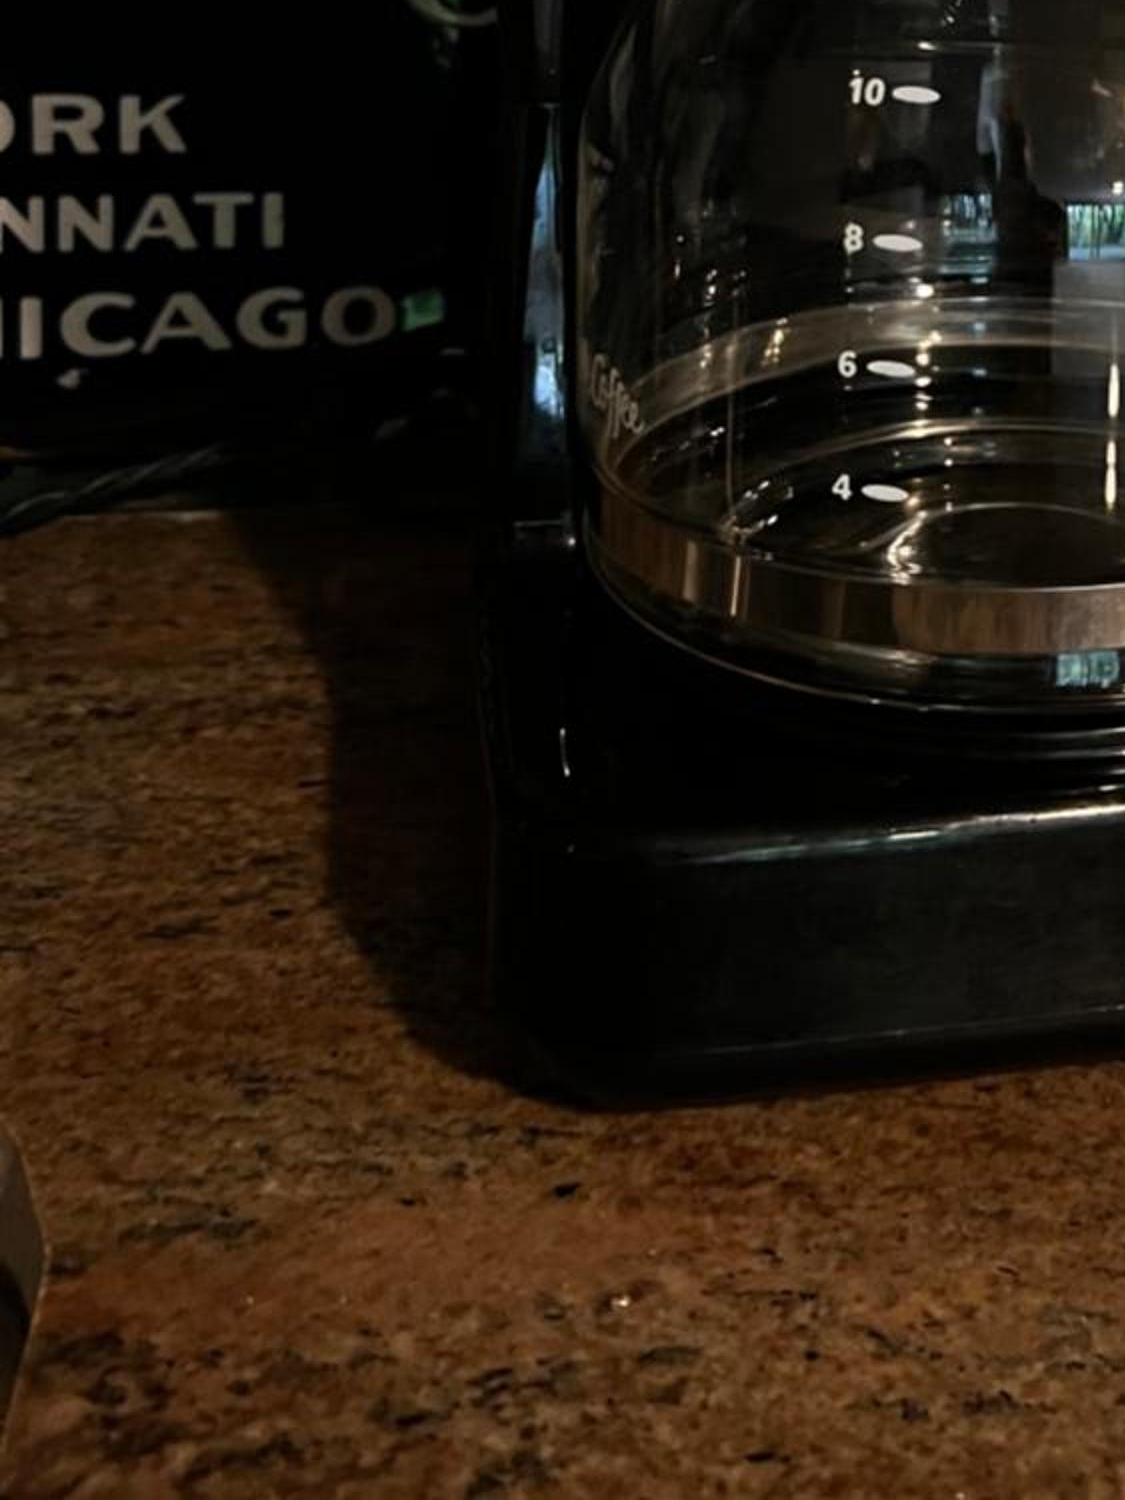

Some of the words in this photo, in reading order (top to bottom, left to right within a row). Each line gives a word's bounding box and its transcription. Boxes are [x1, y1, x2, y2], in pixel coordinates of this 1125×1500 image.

[849, 77, 886, 106] 10
[843, 223, 864, 254] 8
[0, 285, 396, 361] ICAGO
[837, 351, 857, 378] 6
[831, 474, 852, 500] 4
